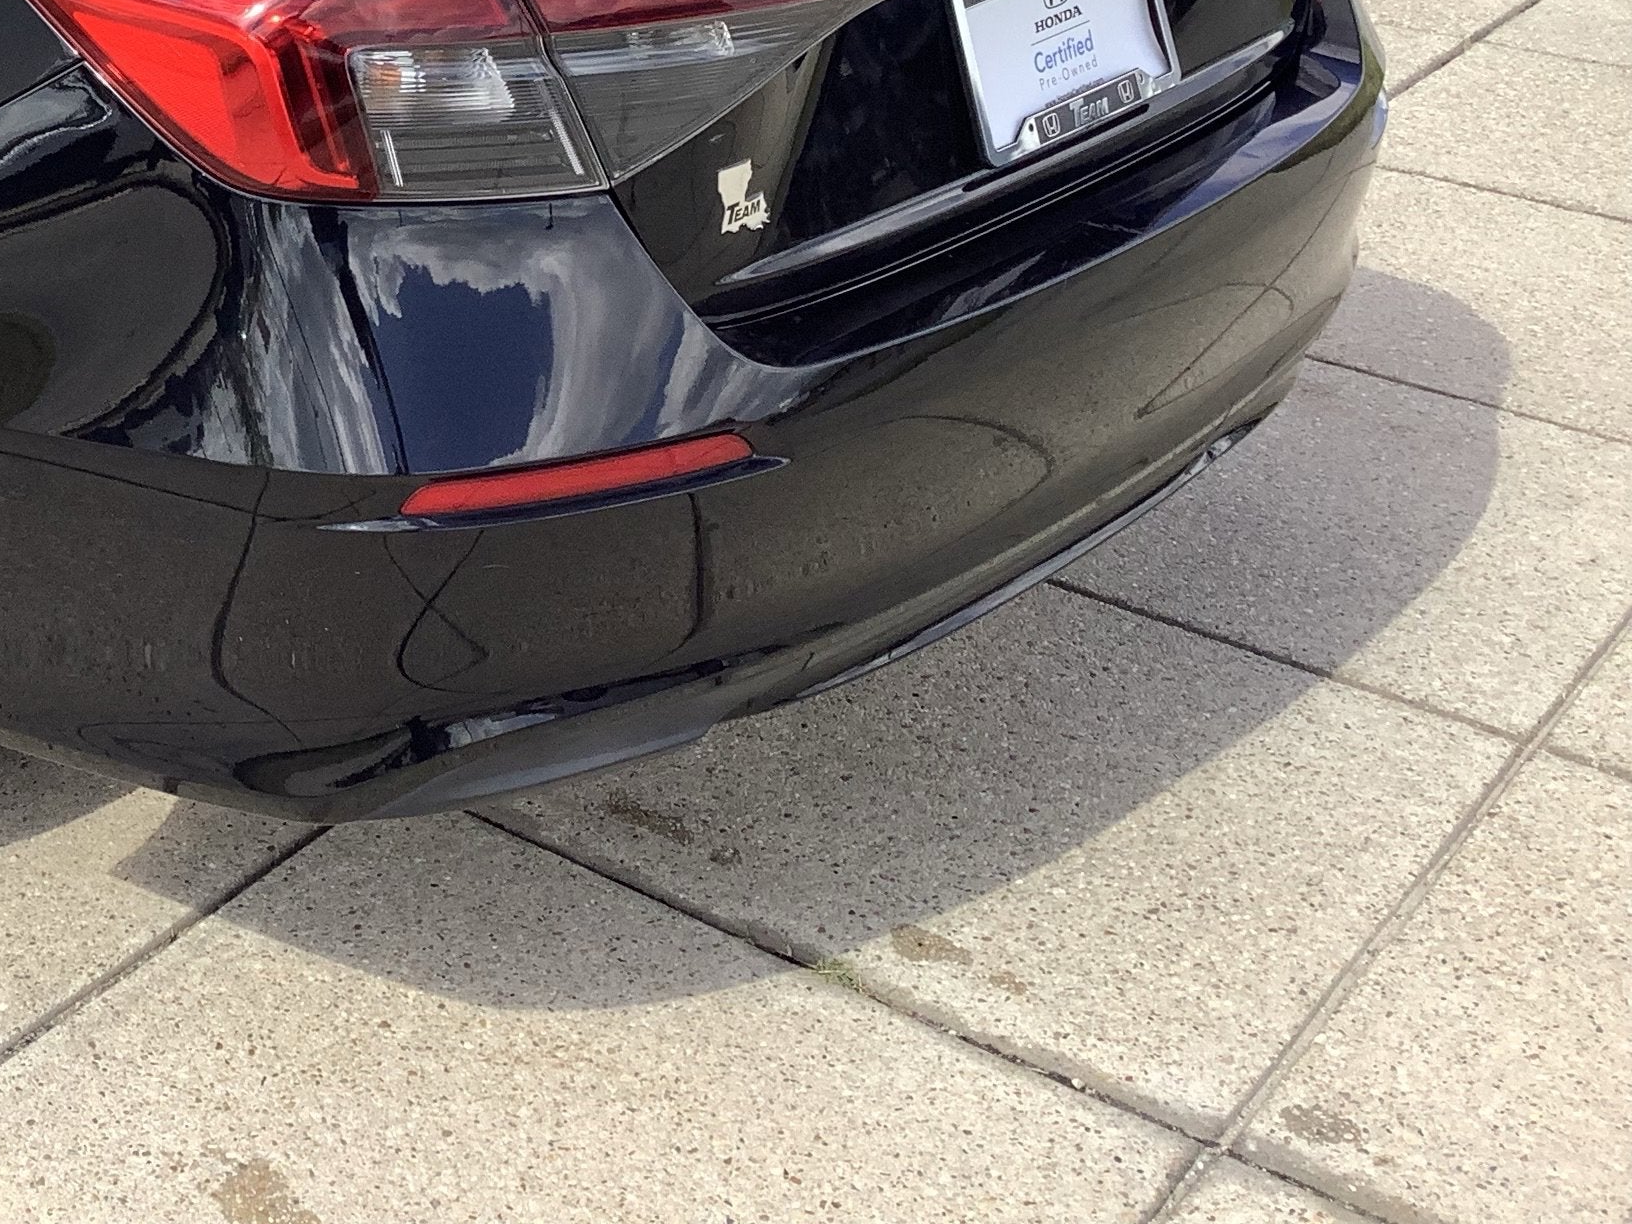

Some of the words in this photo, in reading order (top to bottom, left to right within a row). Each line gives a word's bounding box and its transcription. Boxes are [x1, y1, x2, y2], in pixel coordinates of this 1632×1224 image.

[1034, 5, 1083, 34] HONDA
[1034, 29, 1095, 73] Certified
[1039, 56, 1099, 91] Pre-Owned
[1069, 96, 1110, 128] TEAM
[726, 199, 761, 225] TEAM
